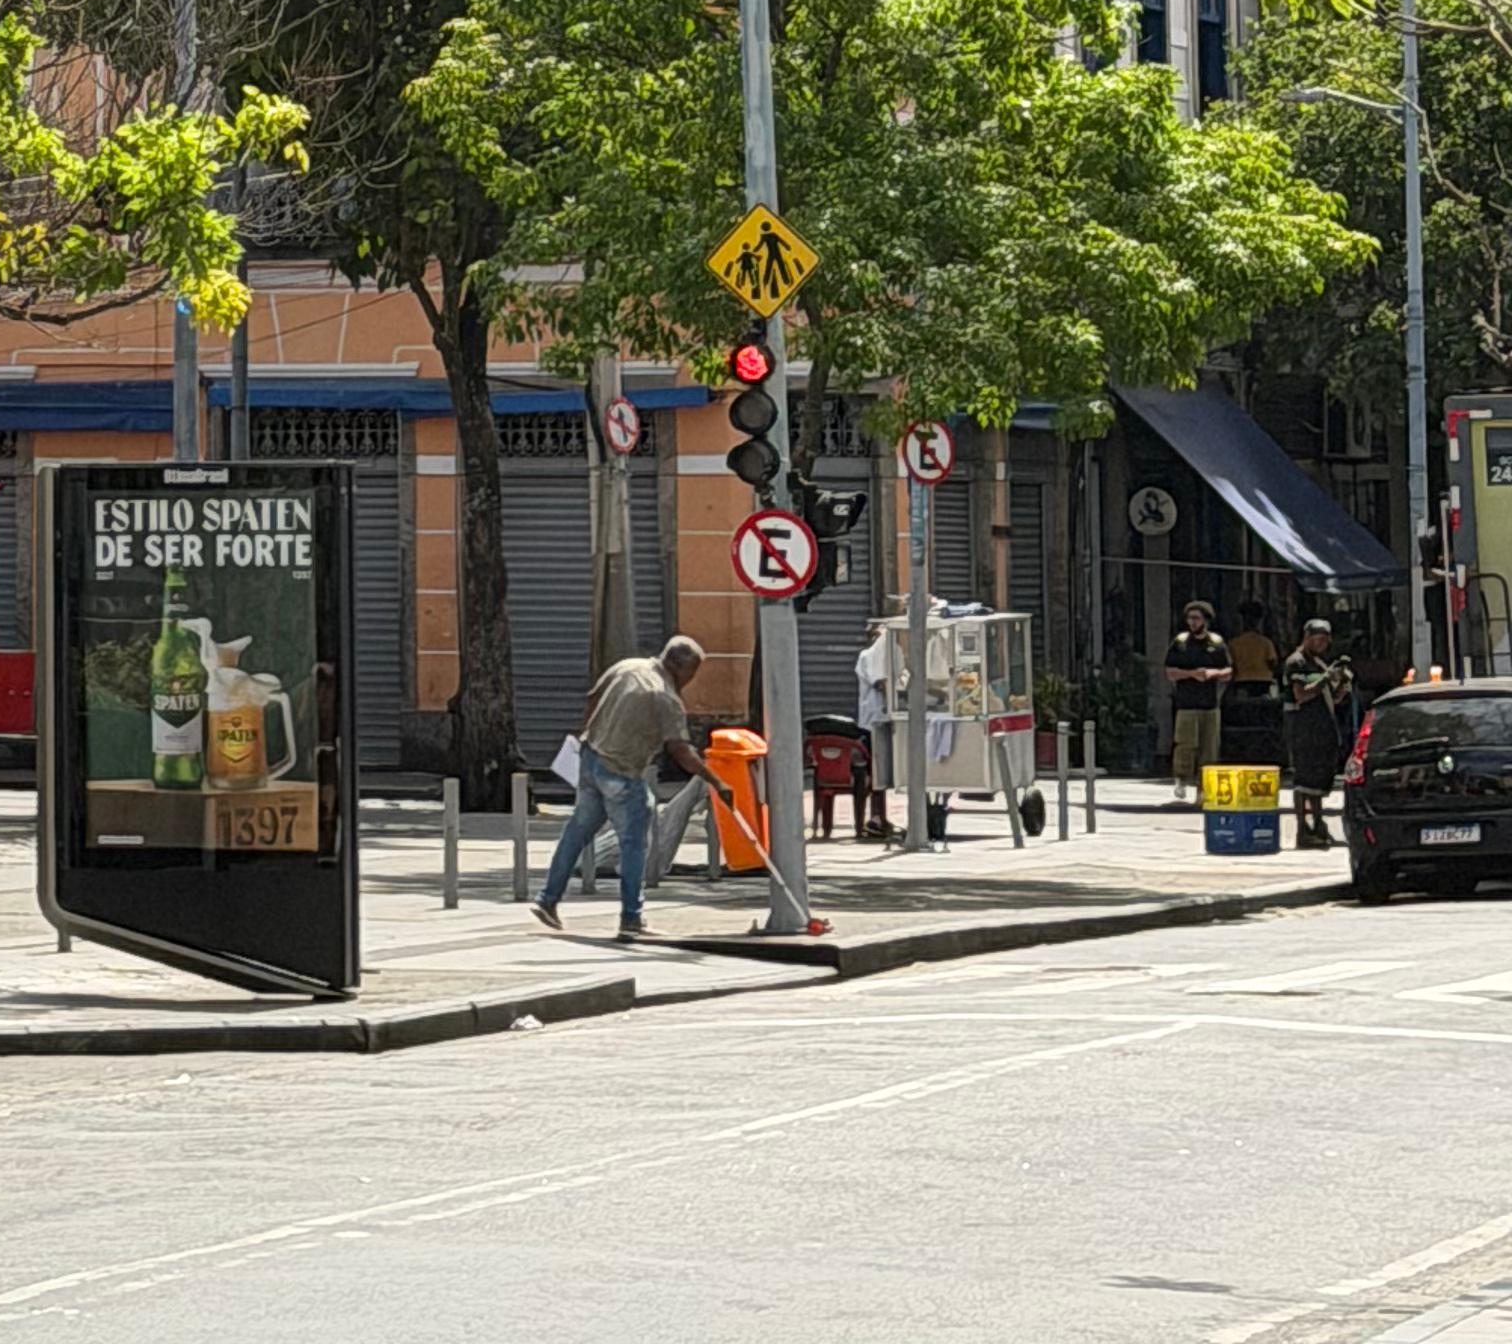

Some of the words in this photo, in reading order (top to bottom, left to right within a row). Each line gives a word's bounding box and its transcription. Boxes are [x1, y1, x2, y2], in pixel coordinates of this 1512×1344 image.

[94, 497, 194, 533] ESTILO
[201, 497, 312, 532] SPATEN
[95, 533, 134, 568] DE
[144, 533, 205, 568] SER
[215, 533, 313, 568] FORTE
[215, 805, 300, 849] 1397
